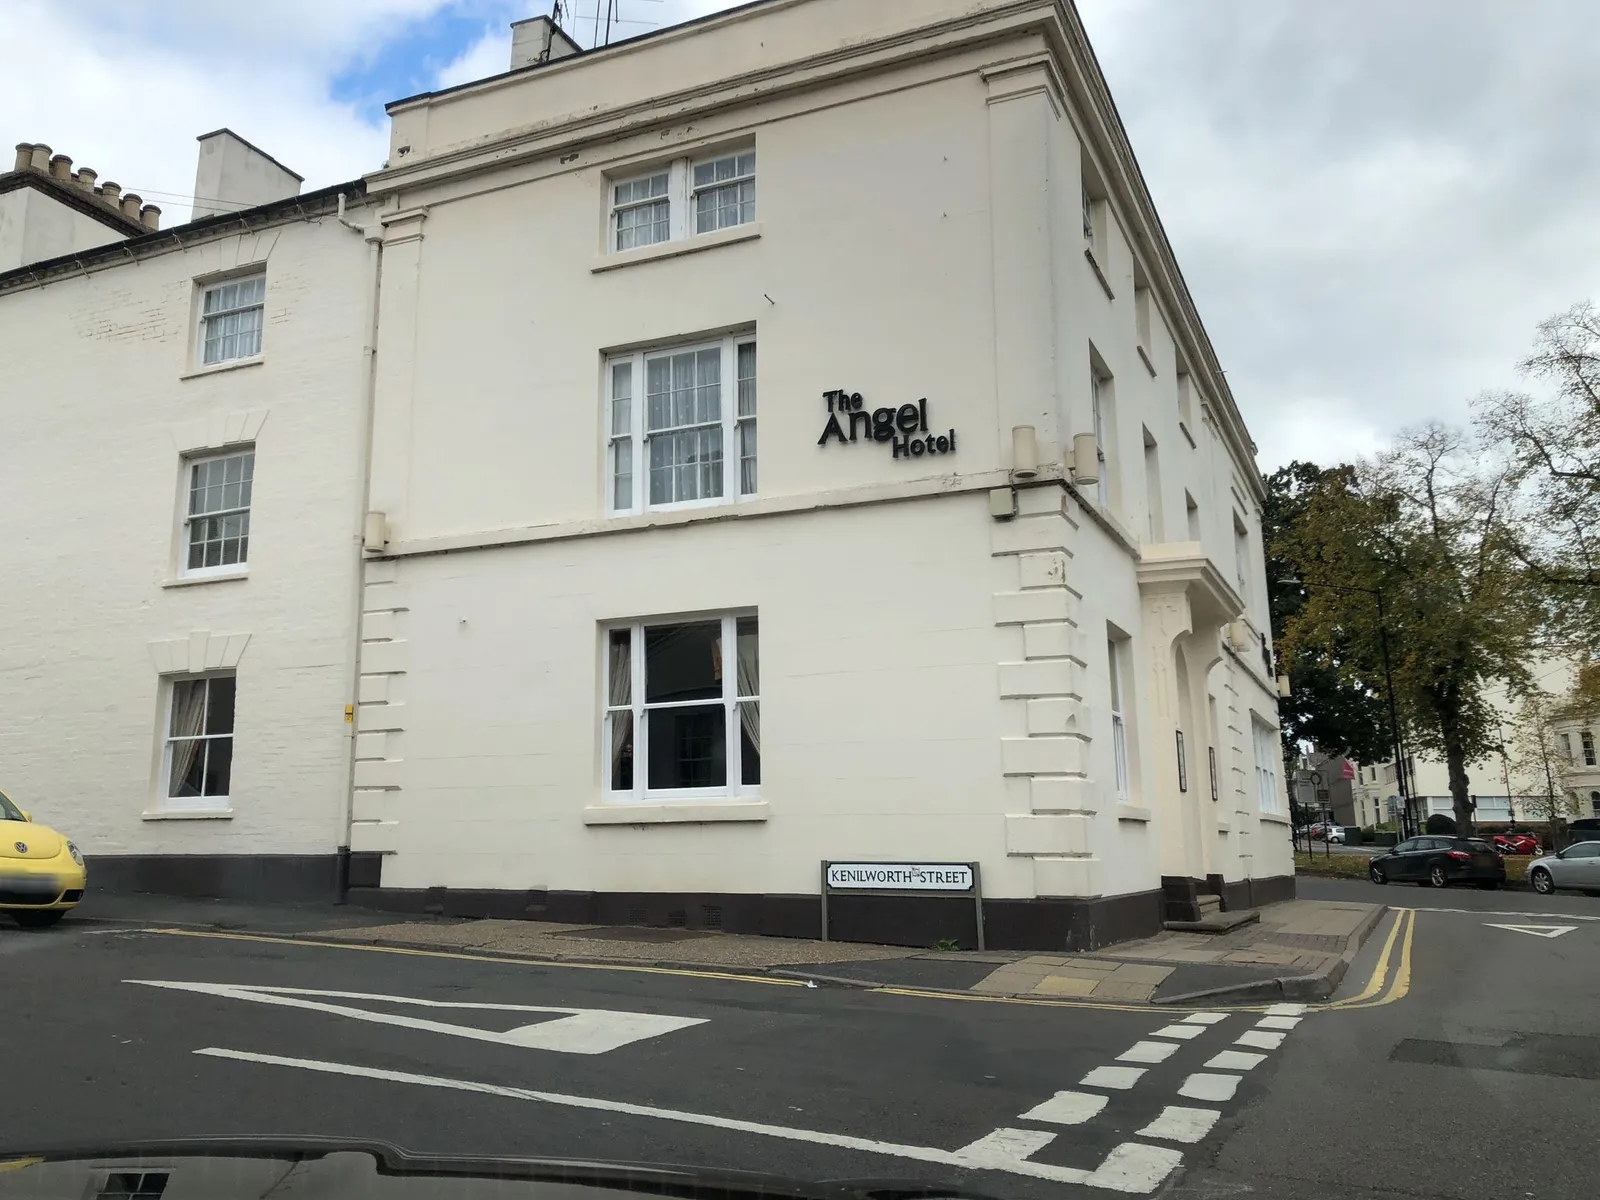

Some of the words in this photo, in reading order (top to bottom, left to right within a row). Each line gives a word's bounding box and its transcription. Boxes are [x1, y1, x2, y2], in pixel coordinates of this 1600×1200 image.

[822, 389, 863, 413] The
[817, 397, 928, 445] Angel
[892, 428, 956, 458] Hotel
[831, 870, 912, 883] KENILWORTH
[920, 871, 968, 884] STREET
